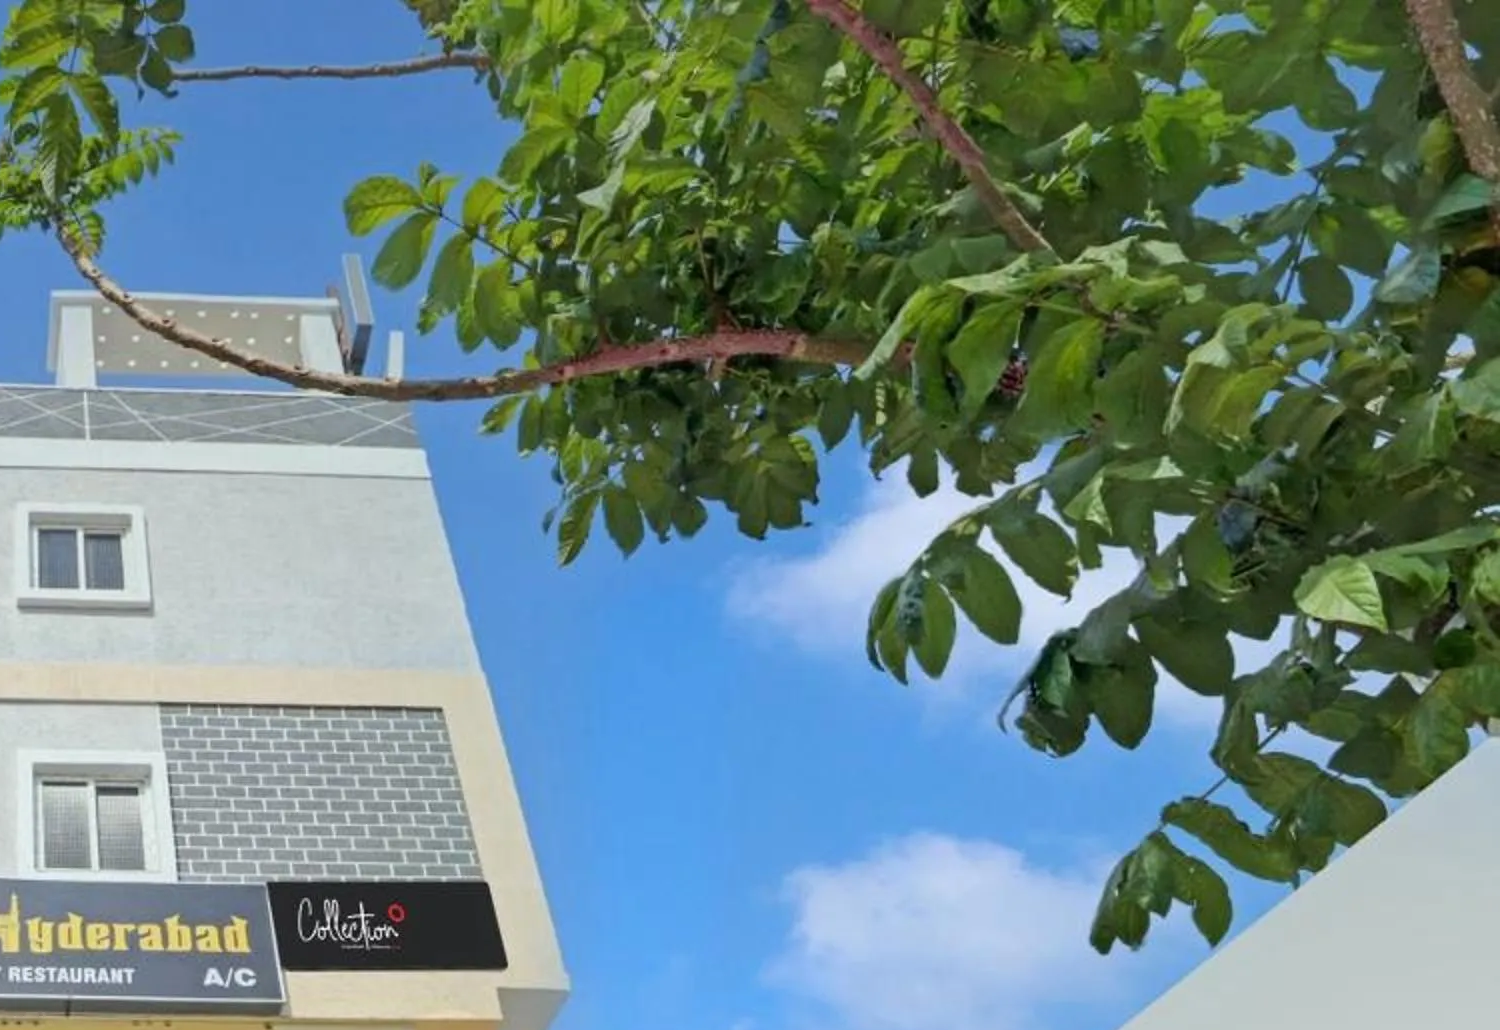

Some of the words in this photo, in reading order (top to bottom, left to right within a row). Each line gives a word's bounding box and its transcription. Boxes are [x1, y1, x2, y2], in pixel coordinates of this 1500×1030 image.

[297, 897, 400, 950] Collection
[7, 966, 136, 985] RESTAURANT
[202, 967, 257, 988] A/C
